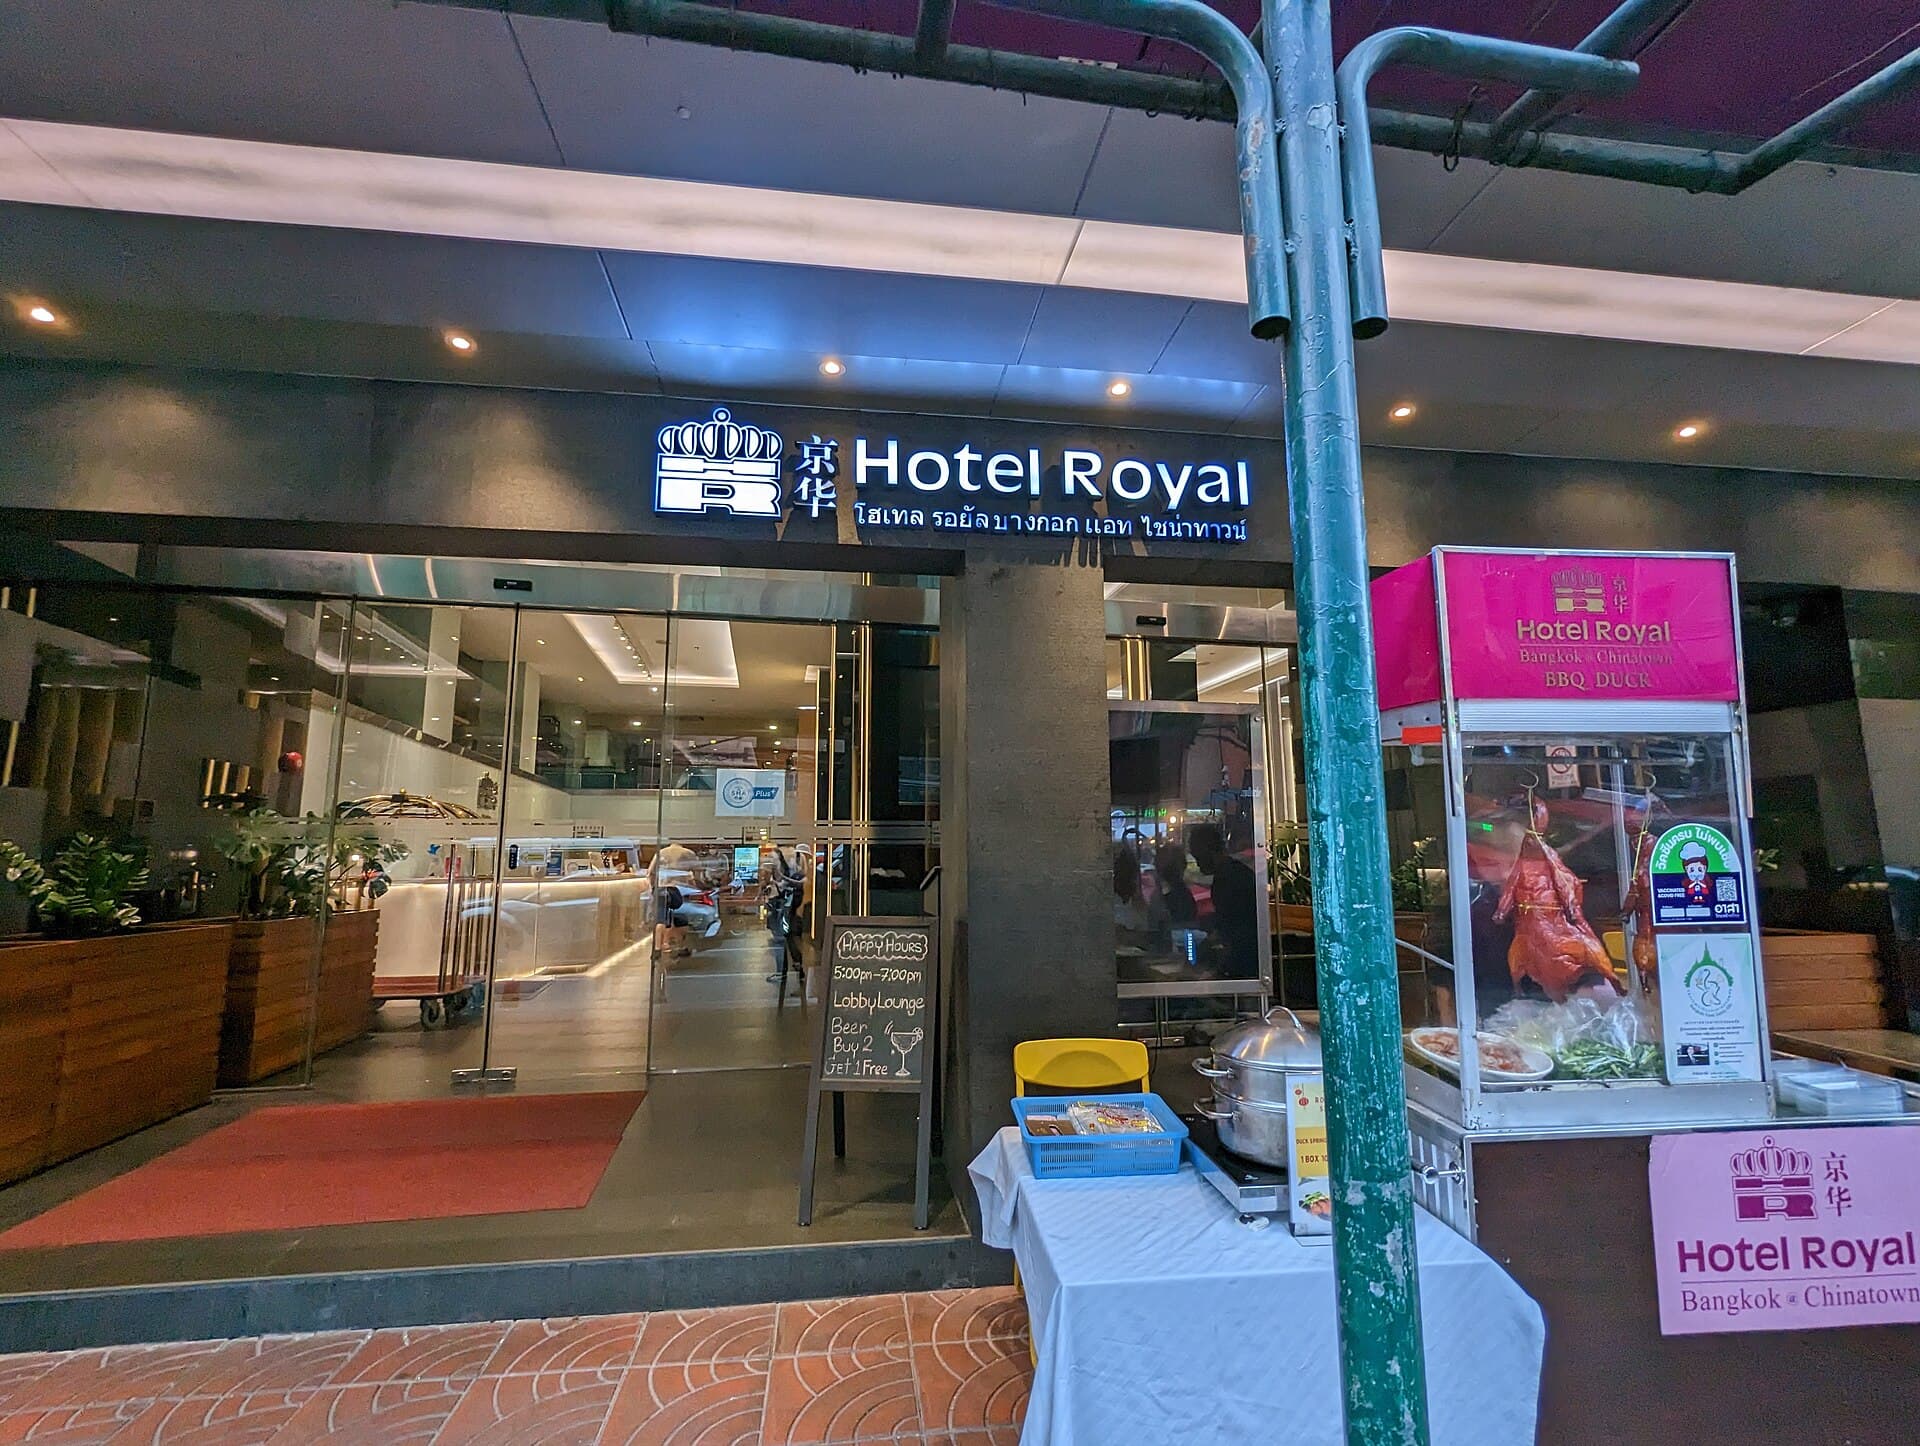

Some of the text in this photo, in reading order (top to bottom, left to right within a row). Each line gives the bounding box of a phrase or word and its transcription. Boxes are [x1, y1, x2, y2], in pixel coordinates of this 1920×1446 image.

[794, 434, 840, 518] 京华
[855, 438, 1250, 511] Hotel Royal
[1516, 619, 1671, 644] Hotel Royal
[1519, 648, 1673, 666] Bangkok Chinatown
[1545, 671, 1652, 691] BBQ DUCK
[842, 937, 923, 955] HAPPY HOURS
[833, 990, 925, 1016] Lobby Lounge
[831, 1016, 868, 1035] Beer
[833, 1035, 873, 1059] Buy 2
[853, 1057, 860, 1075] 1
[862, 1059, 889, 1075] Free
[1305, 1155, 1319, 1163] BOX
[1821, 1151, 1852, 1217] 京华
[1677, 1231, 1916, 1273] Hotel Royal
[1681, 1287, 1782, 1317] Bangkok
[1804, 1284, 1920, 1309] Chinatown
